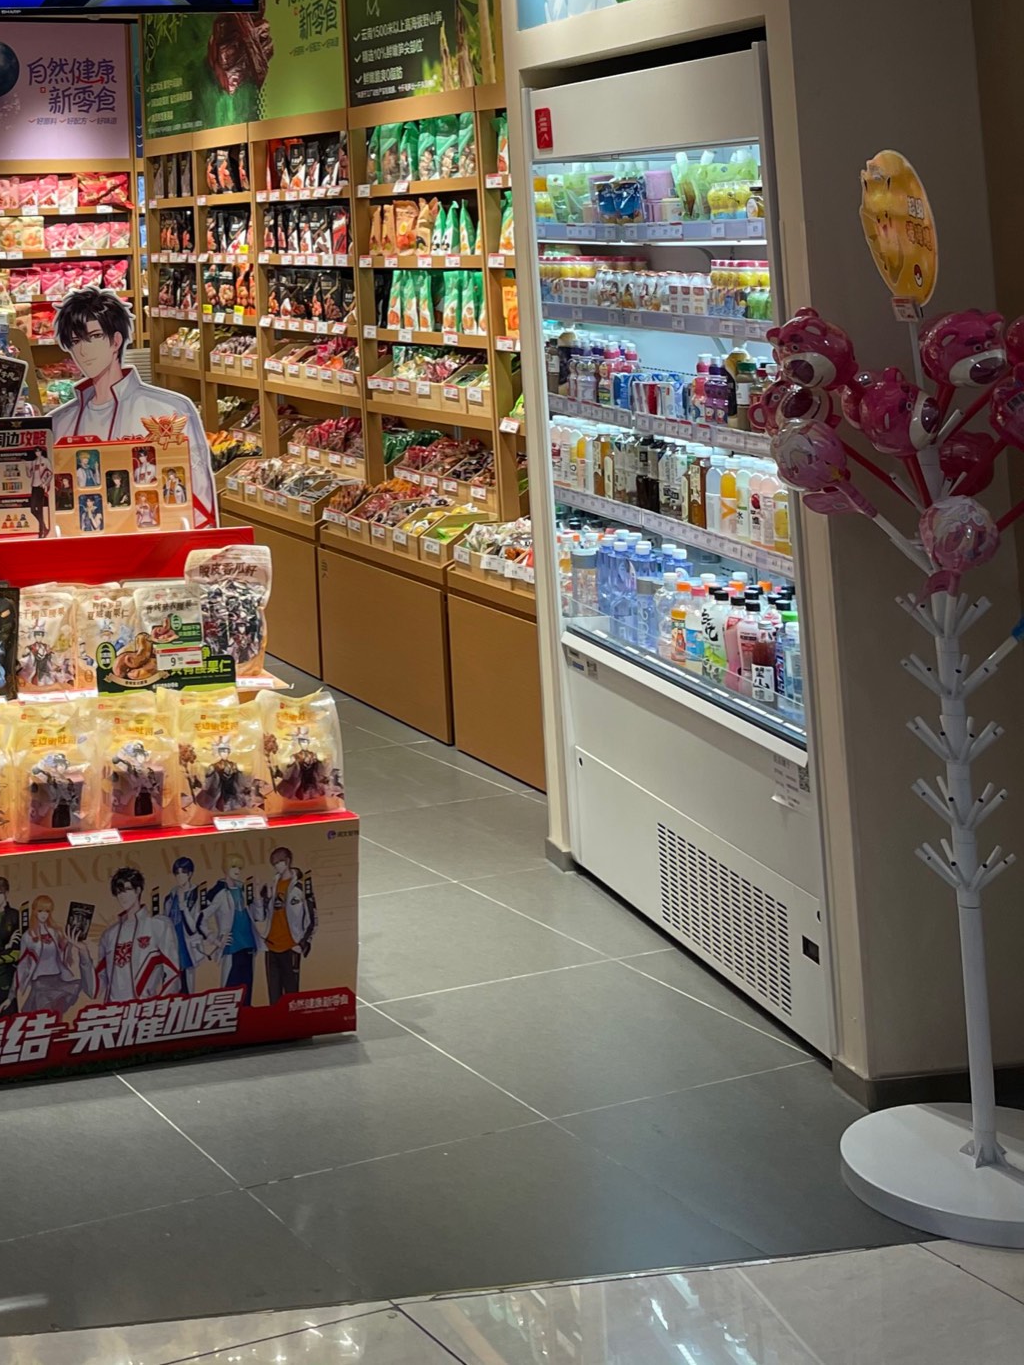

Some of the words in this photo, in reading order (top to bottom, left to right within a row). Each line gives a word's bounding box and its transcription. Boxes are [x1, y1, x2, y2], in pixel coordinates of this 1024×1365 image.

[27, 57, 117, 86] 自然健康
[48, 85, 117, 114] 新零食
[69, 989, 245, 1054] 荣耀加冕
